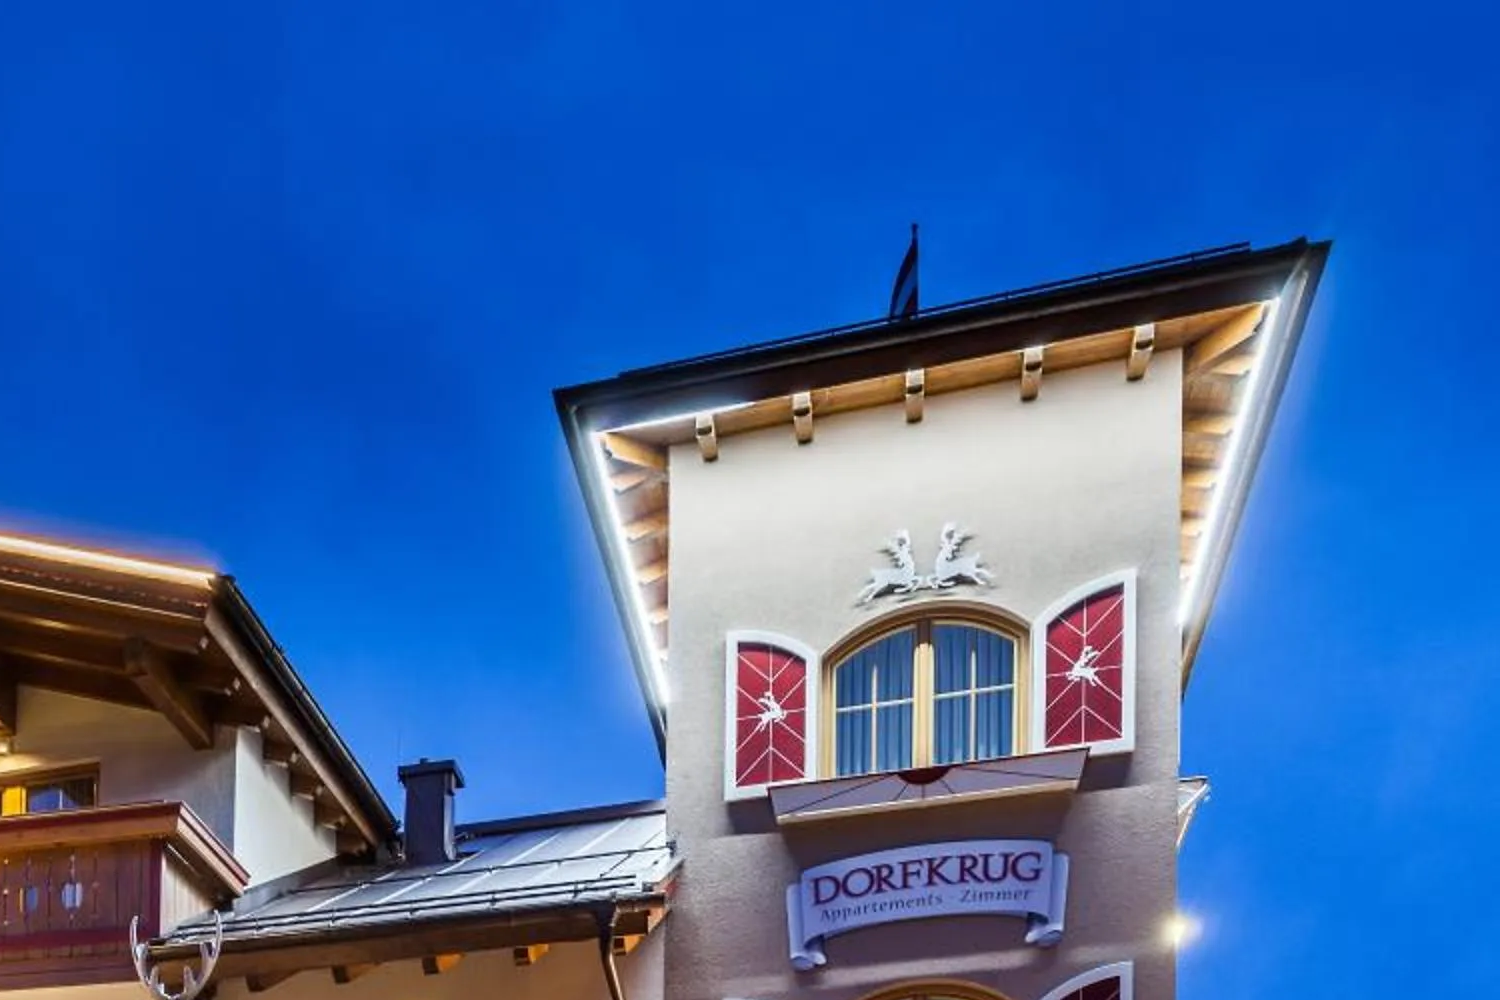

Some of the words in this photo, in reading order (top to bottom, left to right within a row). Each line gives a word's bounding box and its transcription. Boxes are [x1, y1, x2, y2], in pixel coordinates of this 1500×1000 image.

[811, 851, 1043, 906] DORFKRUG
[820, 893, 943, 923] Appartements
[958, 888, 1031, 904] Zimmer
